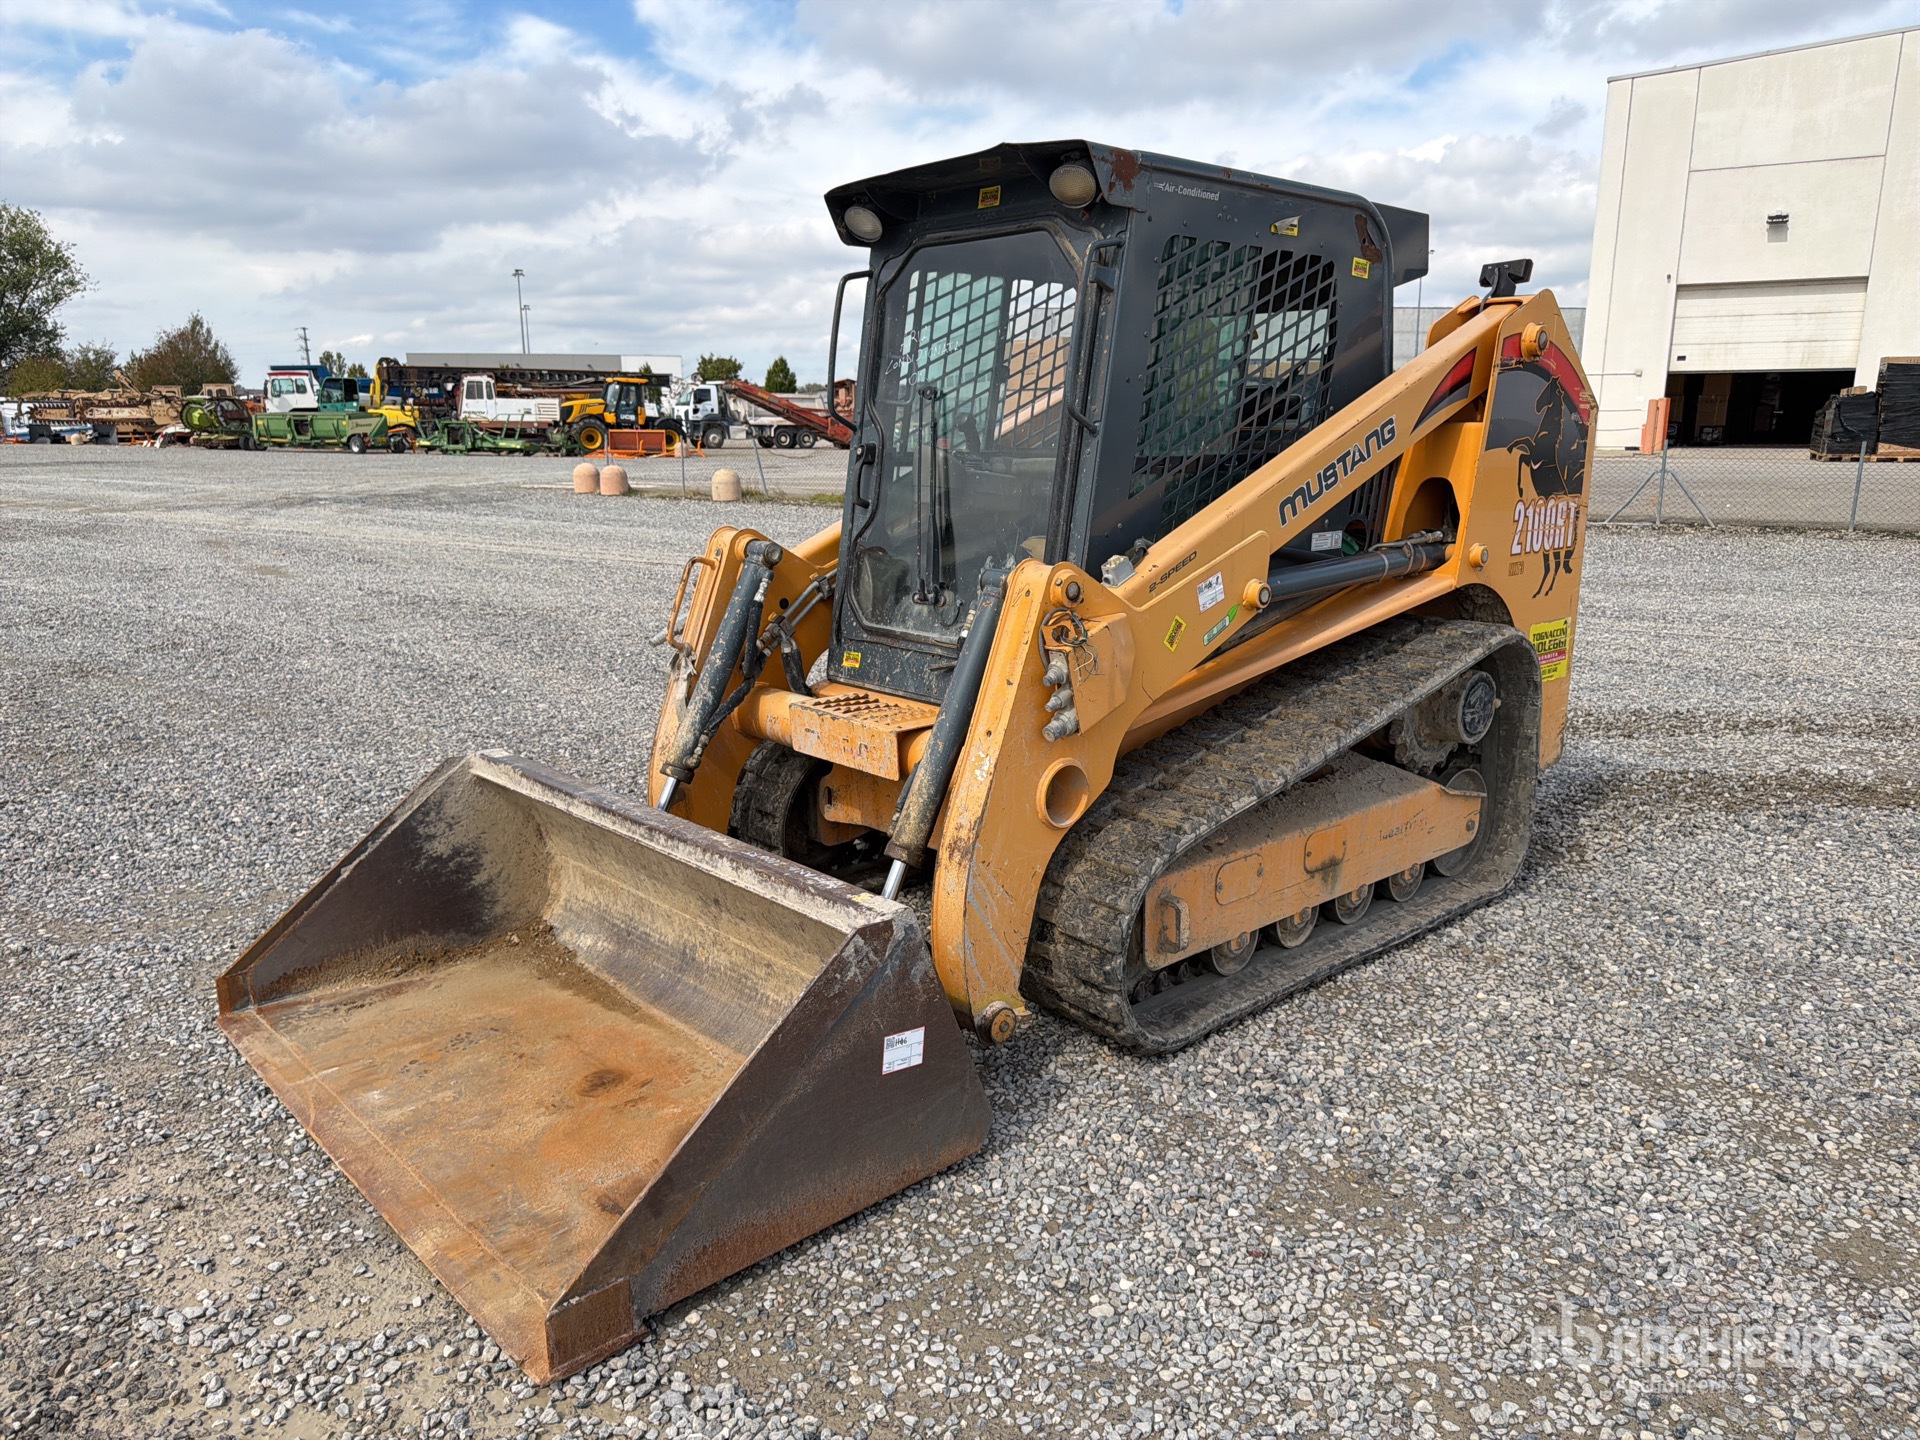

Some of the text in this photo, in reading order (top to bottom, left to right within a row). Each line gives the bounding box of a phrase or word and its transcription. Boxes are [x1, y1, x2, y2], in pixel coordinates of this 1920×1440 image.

[1164, 182, 1220, 202] Air-Conditioned
[1278, 415, 1396, 528] MUSTANG
[1148, 550, 1198, 594] 2-SPEED
